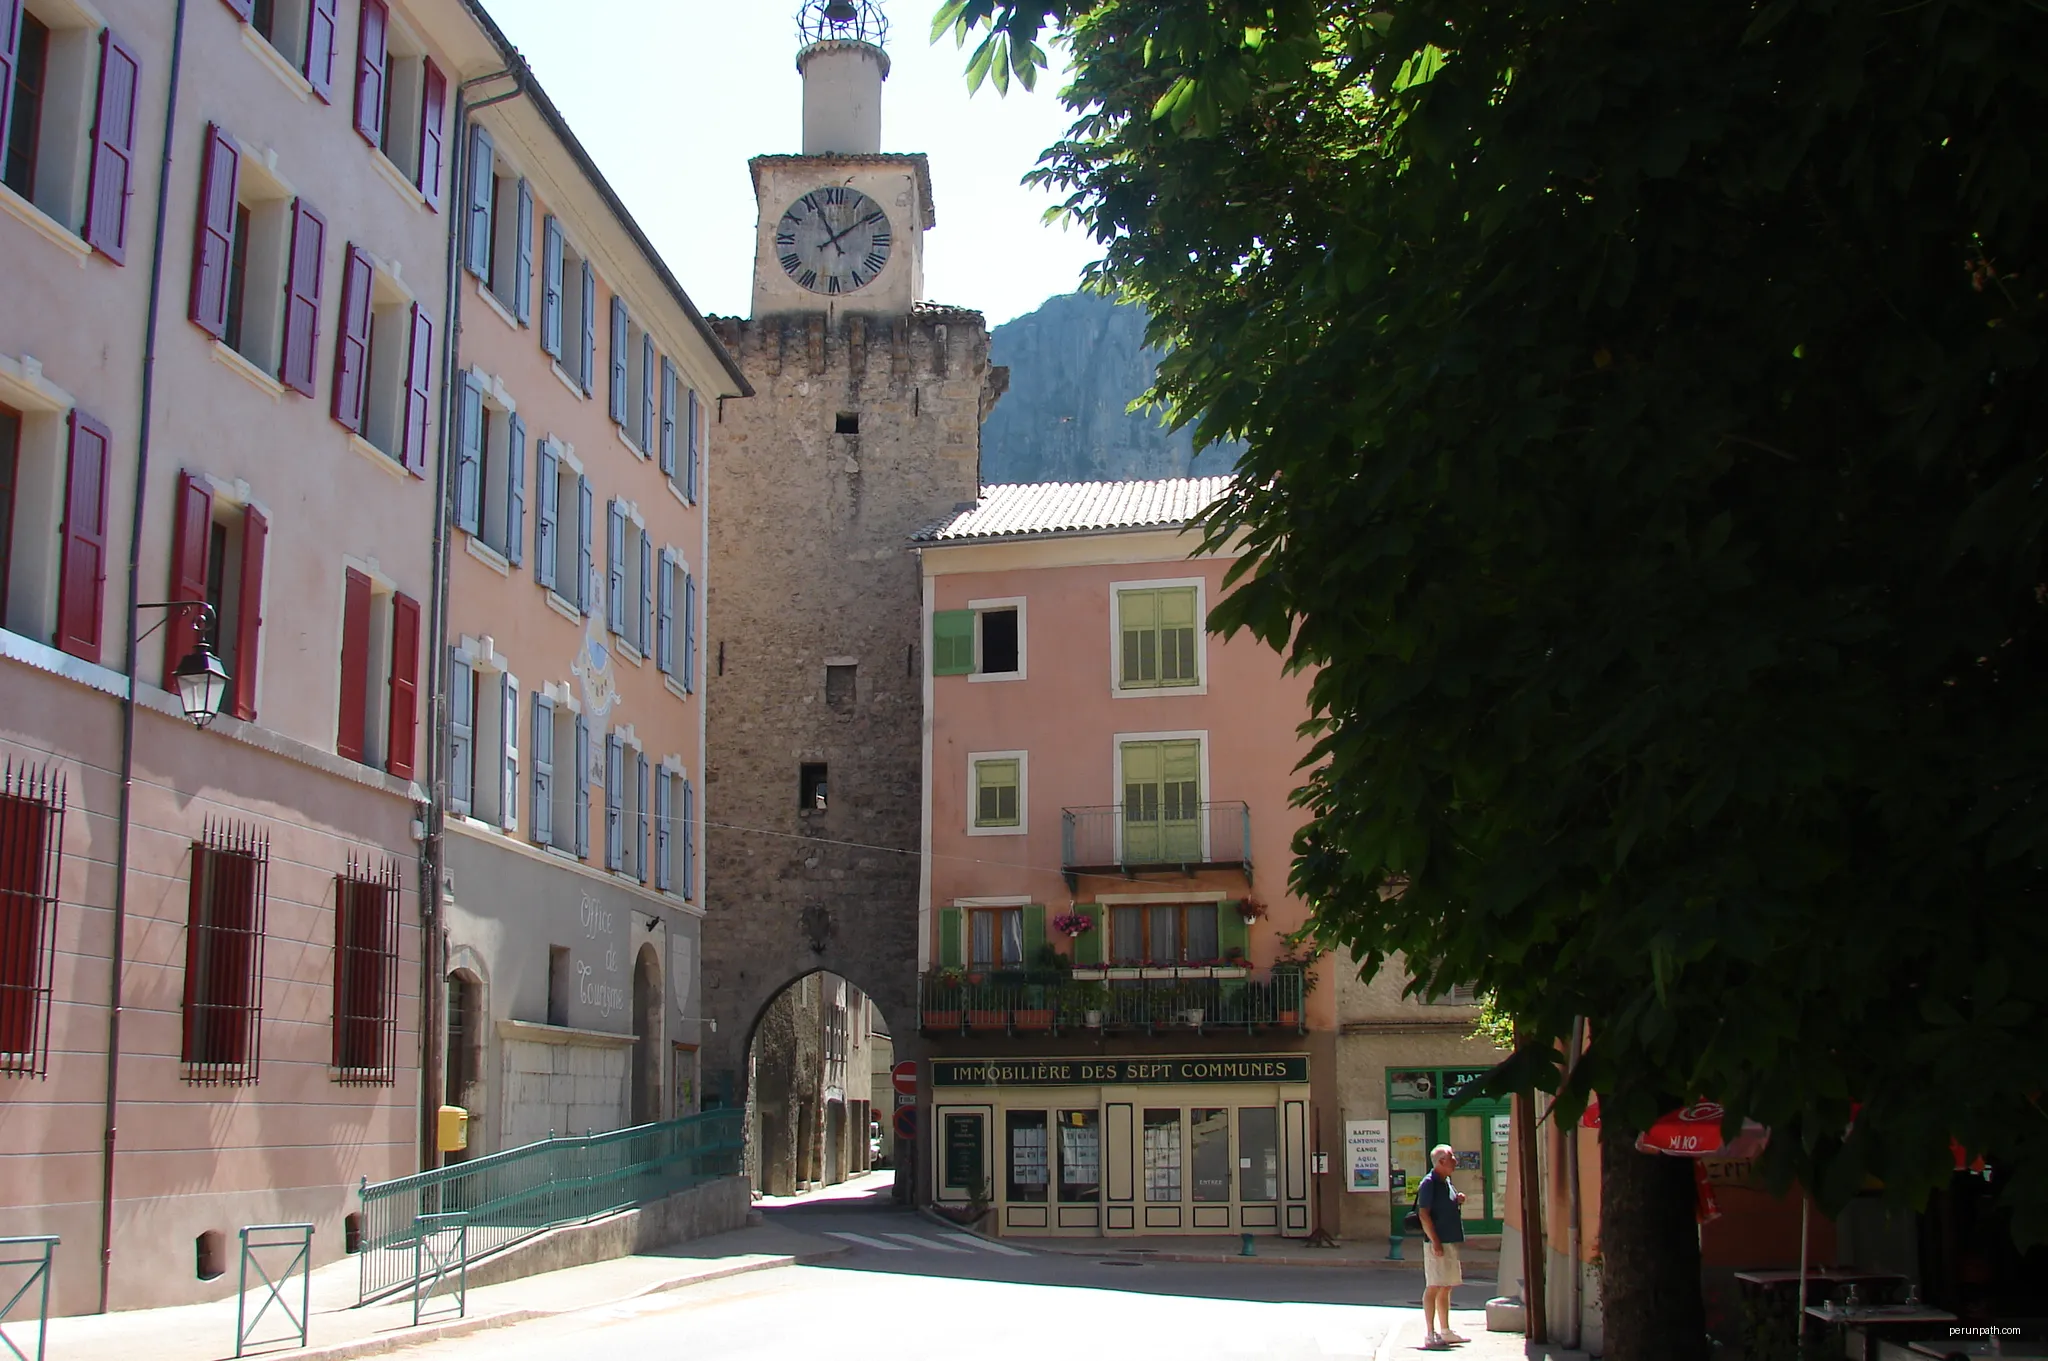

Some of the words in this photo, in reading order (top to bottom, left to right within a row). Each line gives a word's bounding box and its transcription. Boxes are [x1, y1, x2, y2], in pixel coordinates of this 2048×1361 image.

[580, 888, 613, 940] Office
[605, 941, 618, 972] de
[576, 959, 624, 1018] Tourisme
[953, 1062, 1071, 1081] IMMOBILIÈRE
[1081, 1065, 1117, 1079] DES
[1127, 1064, 1172, 1079] SEPT
[1181, 1062, 1287, 1078] COMMUNES
